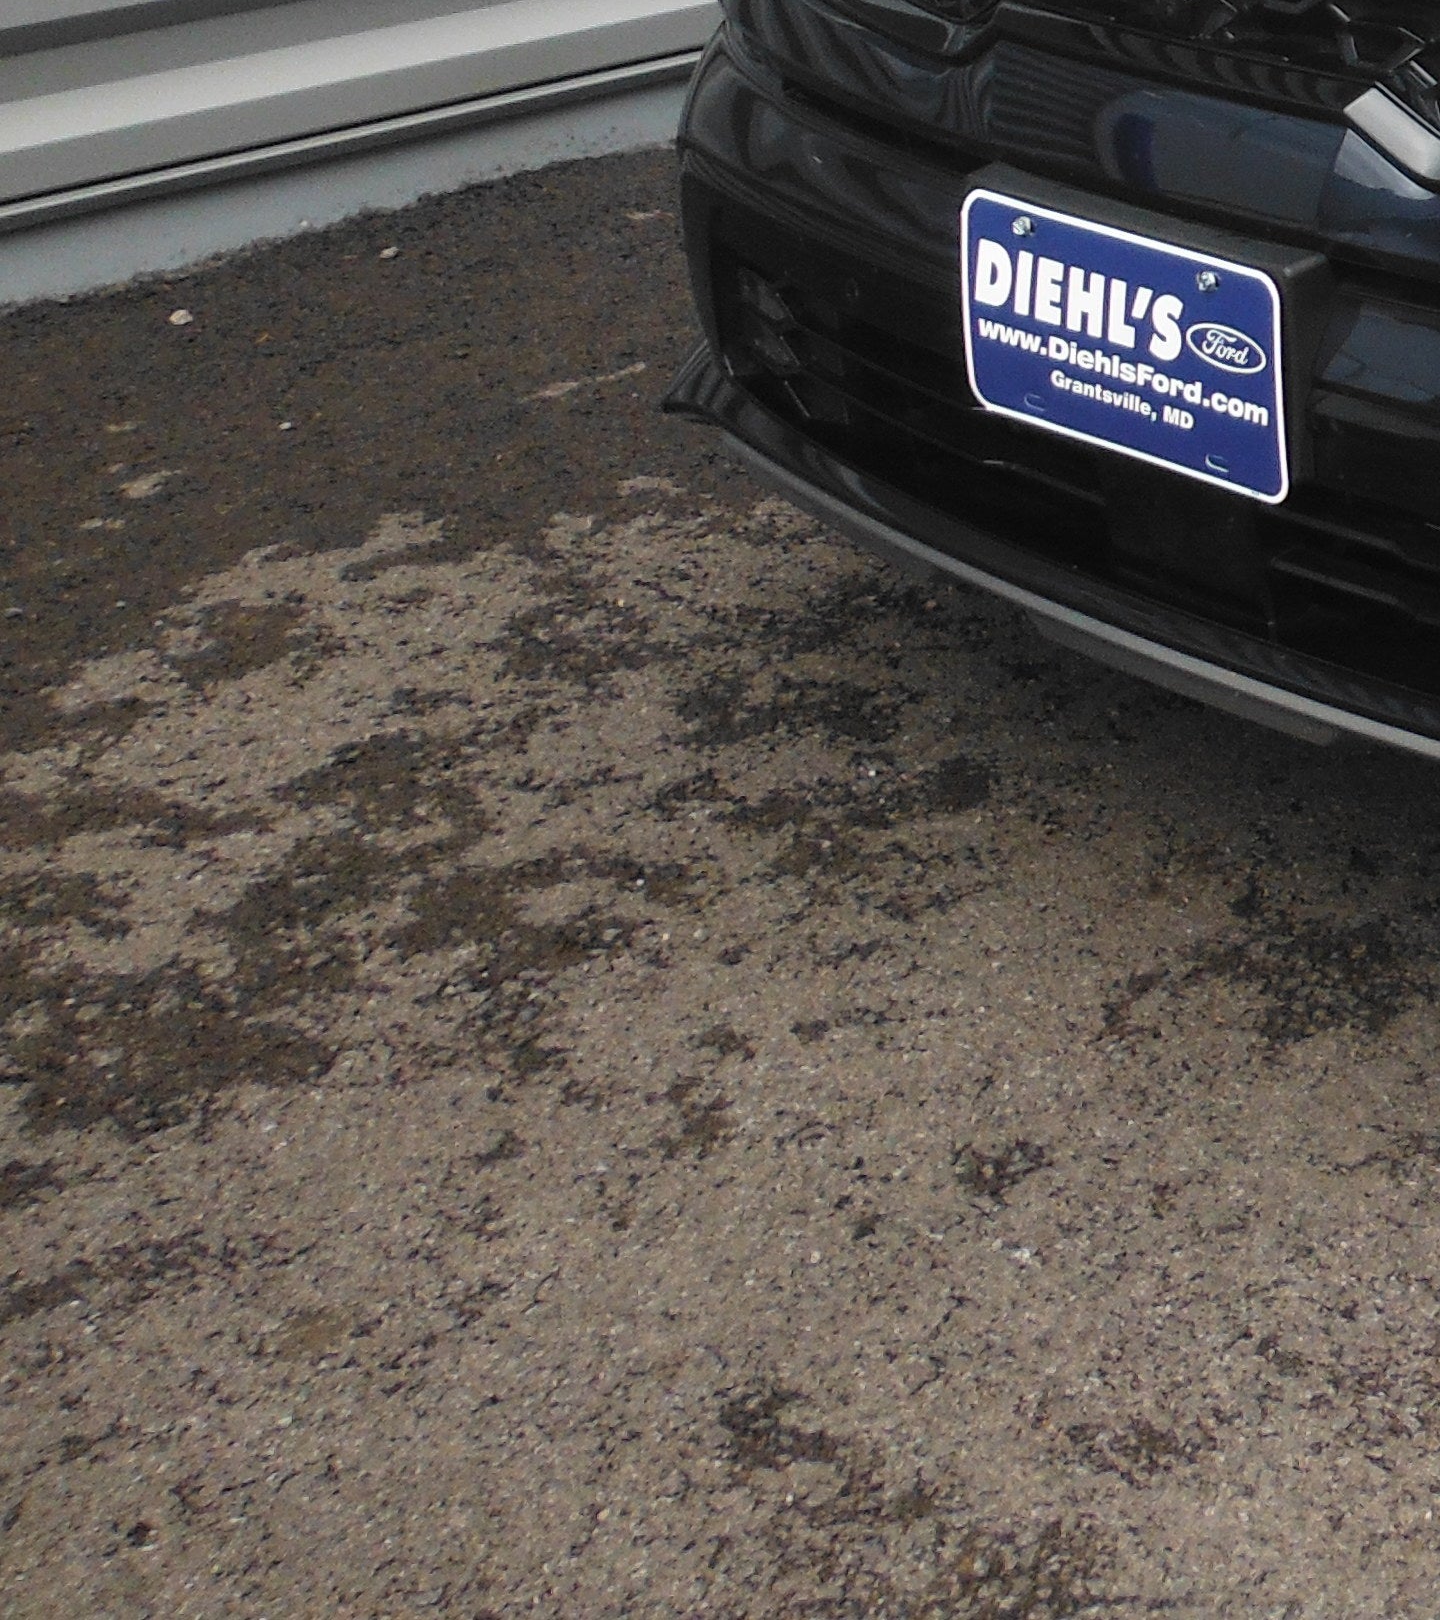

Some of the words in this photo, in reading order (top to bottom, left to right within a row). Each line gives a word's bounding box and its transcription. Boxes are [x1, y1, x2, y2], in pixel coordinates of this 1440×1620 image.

[974, 238, 1184, 361] DIEHL'S
[978, 317, 1269, 427] www.DiehlsFord.com
[1202, 329, 1249, 366] Ford
[1050, 369, 1157, 422] Grantsville,
[1163, 404, 1194, 430] MD
